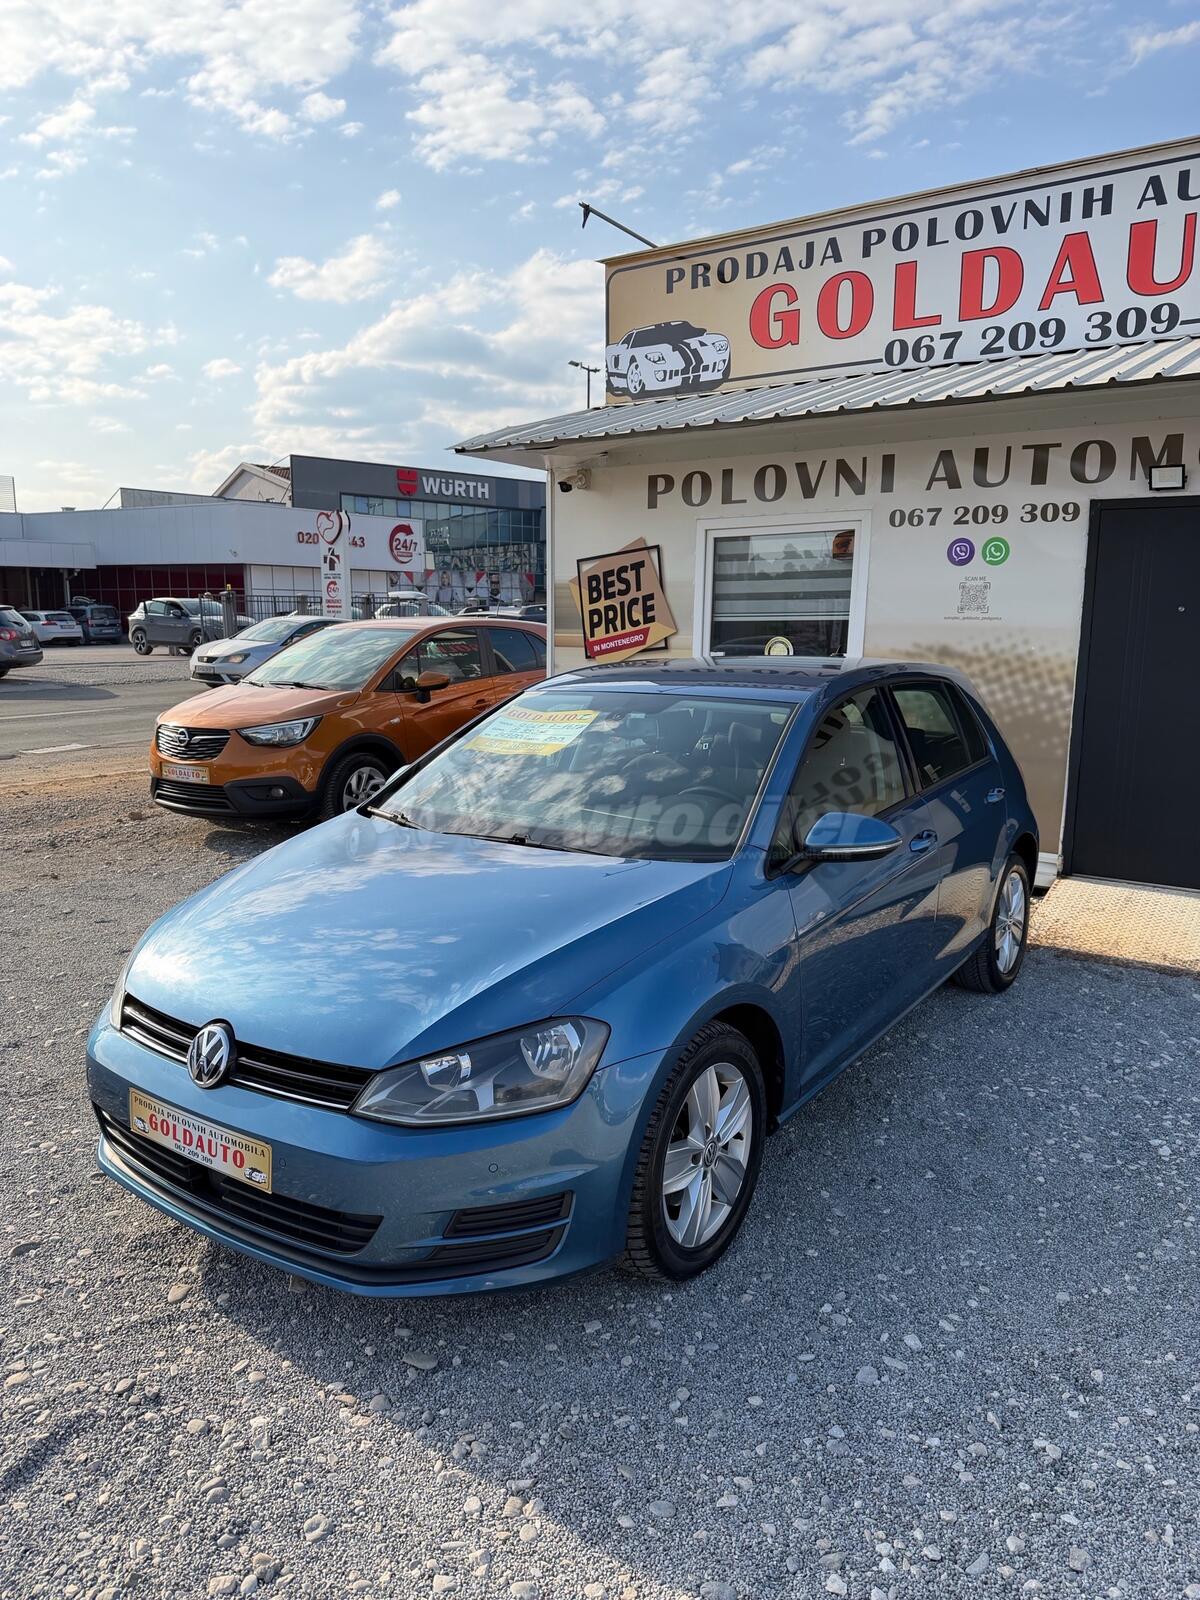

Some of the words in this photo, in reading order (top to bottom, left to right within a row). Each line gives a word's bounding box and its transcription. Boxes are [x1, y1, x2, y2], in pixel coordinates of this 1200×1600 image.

[666, 236, 843, 294] PRODAJA
[862, 183, 1114, 258] POLOVNIH
[749, 212, 1197, 349] GOLDAU
[884, 331, 963, 366] 067
[980, 318, 1066, 355] 209
[1084, 302, 1180, 343] 309
[422, 476, 490, 499] WÜRTH
[647, 453, 895, 509] POLOVNI
[889, 507, 943, 528] 067
[953, 504, 1009, 525] 209
[1020, 502, 1081, 523] 309
[297, 531, 320, 545] 020
[394, 538, 418, 552] 24/7
[587, 560, 645, 605] BEST
[588, 592, 656, 638] PRICE
[593, 643, 600, 652] IN
[601, 633, 644, 650] MONTENEGRO
[508, 710, 542, 721] GOLD
[545, 713, 576, 722] AUTO
[168, 767, 200, 779] GOLDAUTO
[134, 1096, 165, 1117] PRODAJA
[166, 1110, 206, 1134] POLOVNIH
[208, 1129, 266, 1158] AUTOMOBILA
[148, 1113, 245, 1168] GOLDAUTO
[174, 1143, 186, 1153] 067
[187, 1148, 200, 1160] 209
[200, 1154, 213, 1165] 309
